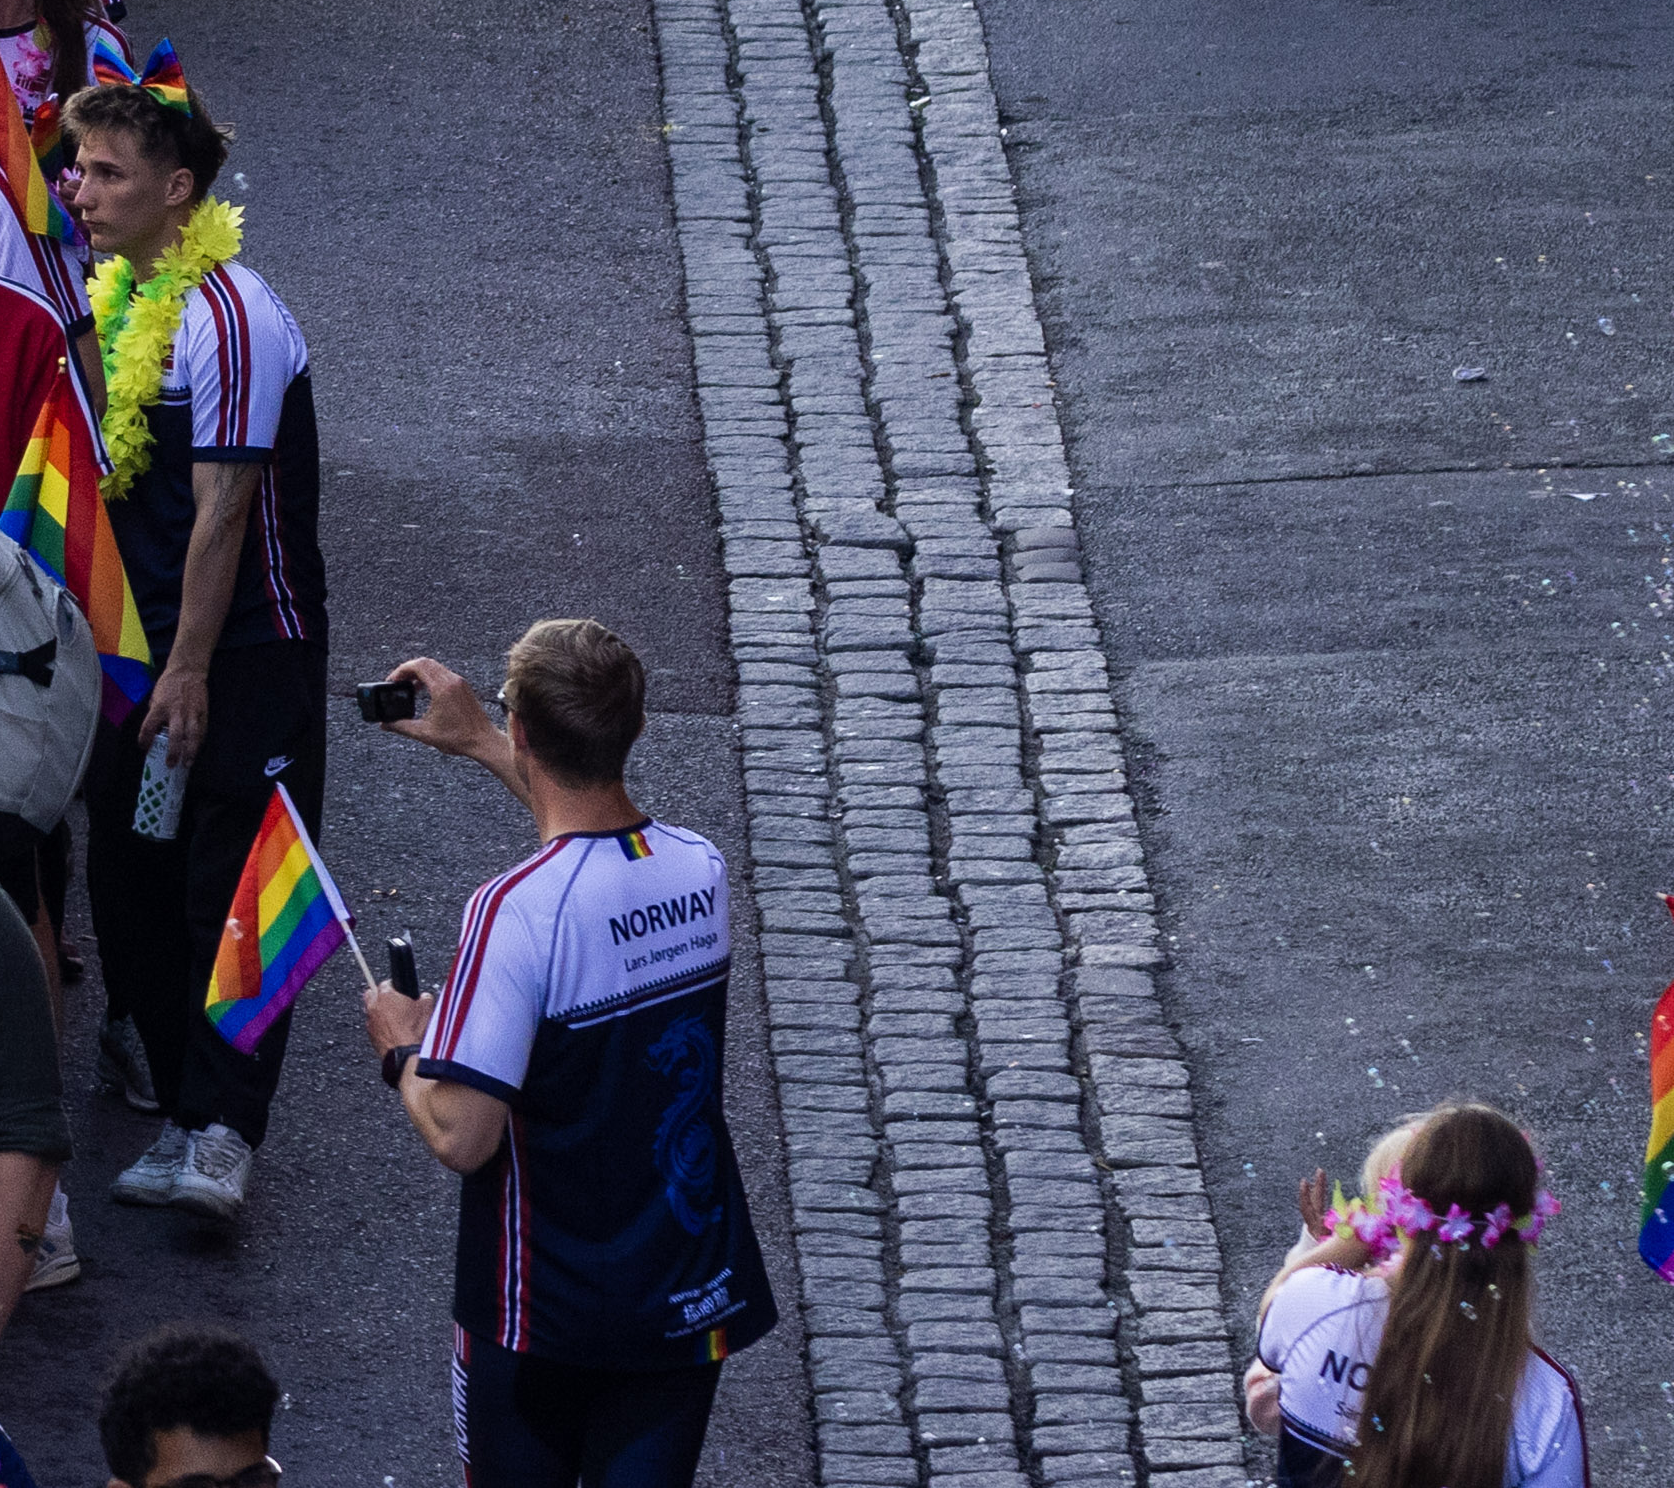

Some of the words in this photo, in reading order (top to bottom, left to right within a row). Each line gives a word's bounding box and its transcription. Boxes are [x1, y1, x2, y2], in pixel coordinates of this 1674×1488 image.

[608, 886, 718, 947] NORWAY
[622, 950, 650, 973] Lars
[649, 939, 688, 969] Jørgen
[689, 929, 720, 957] Haga
